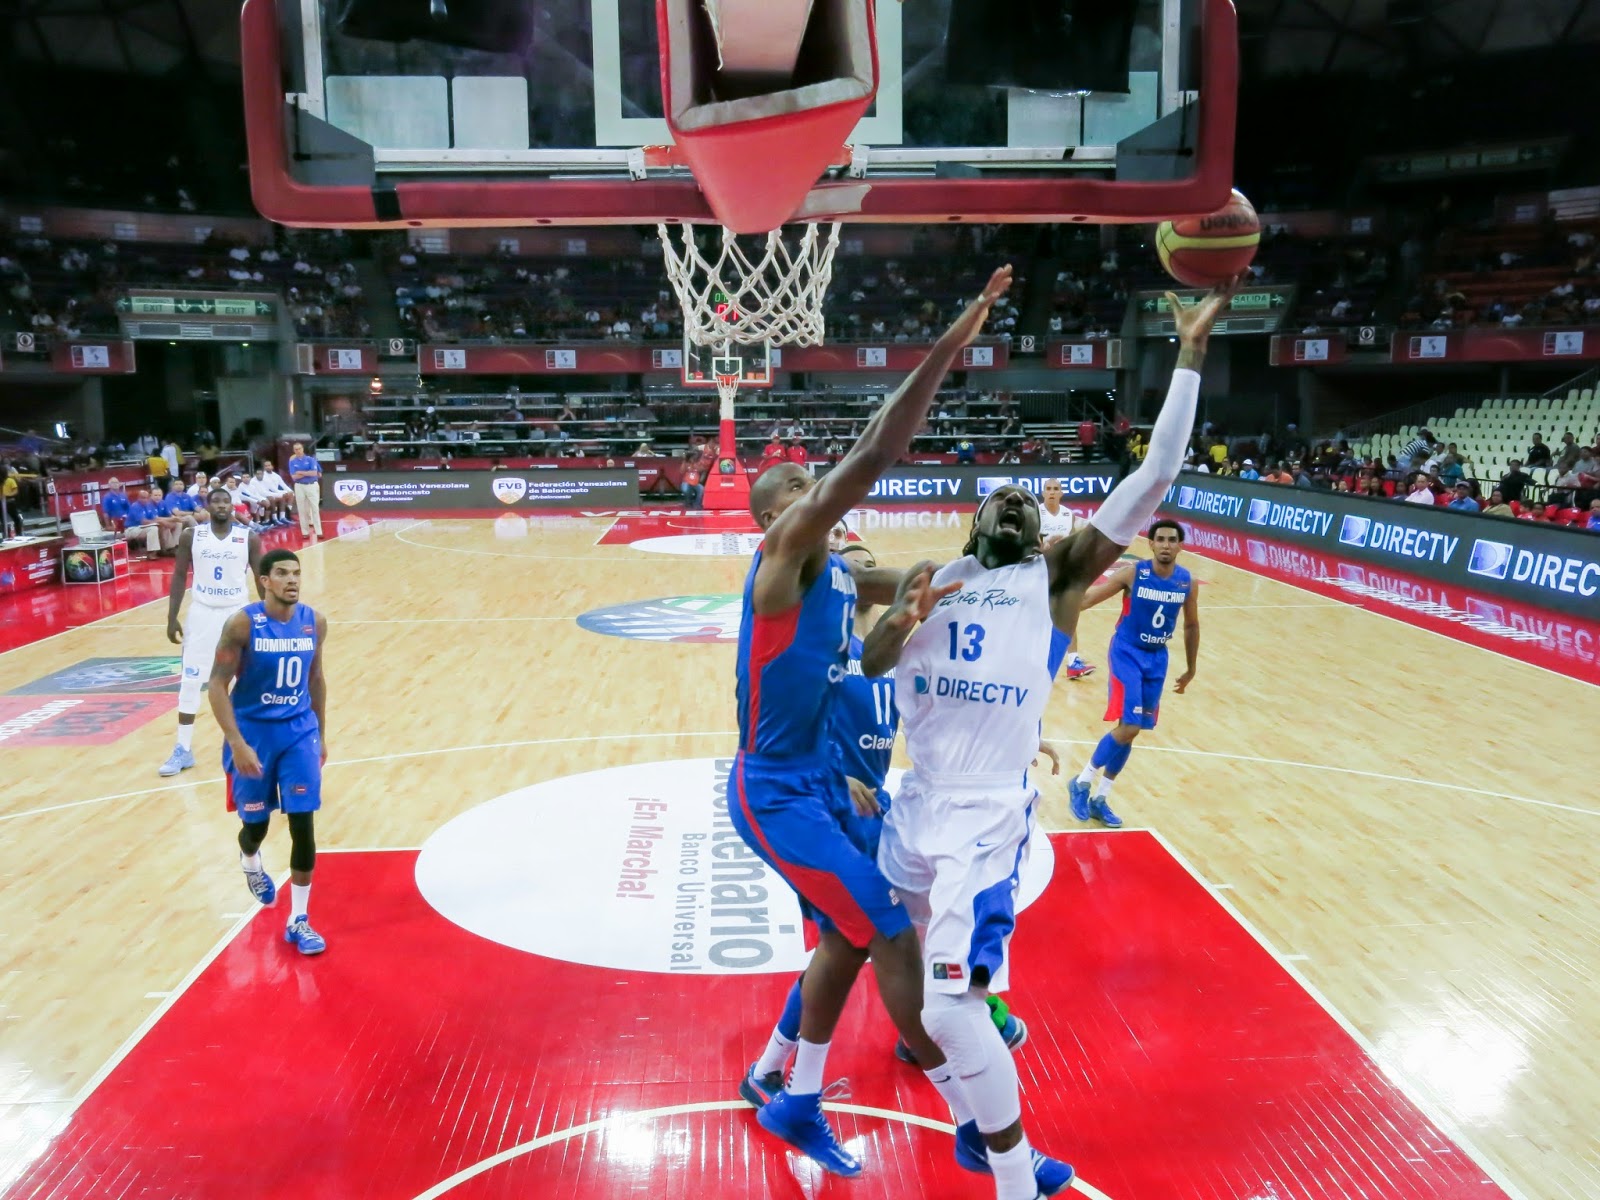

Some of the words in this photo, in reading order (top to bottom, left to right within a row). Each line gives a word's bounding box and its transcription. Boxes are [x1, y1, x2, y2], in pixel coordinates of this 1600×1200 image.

[143, 304, 163, 312] EXIT
[225, 306, 245, 314] EXIT
[1234, 294, 1266, 303] SALIDA
[498, 482, 522, 490] FVB
[1195, 490, 1243, 517] DIRECTV
[1269, 502, 1334, 536] DIRECTV
[1370, 522, 1459, 564] DIRECTV
[214, 566, 223, 580] 6
[1512, 550, 1600, 596] DIREC
[980, 589, 1020, 611] Rico
[1137, 586, 1186, 603] DOMINICANA
[1152, 604, 1165, 628] 6
[255, 637, 314, 652] DOMINICANA
[948, 621, 986, 662] 13
[1140, 633, 1167, 644] Claro
[276, 656, 302, 689] 10
[260, 690, 300, 706] Claro
[872, 683, 891, 725] 11
[936, 676, 1028, 707] DIRECTV
[616, 825, 664, 900] Marcha!
[679, 832, 707, 876] Banco
[670, 882, 705, 971] Universal
